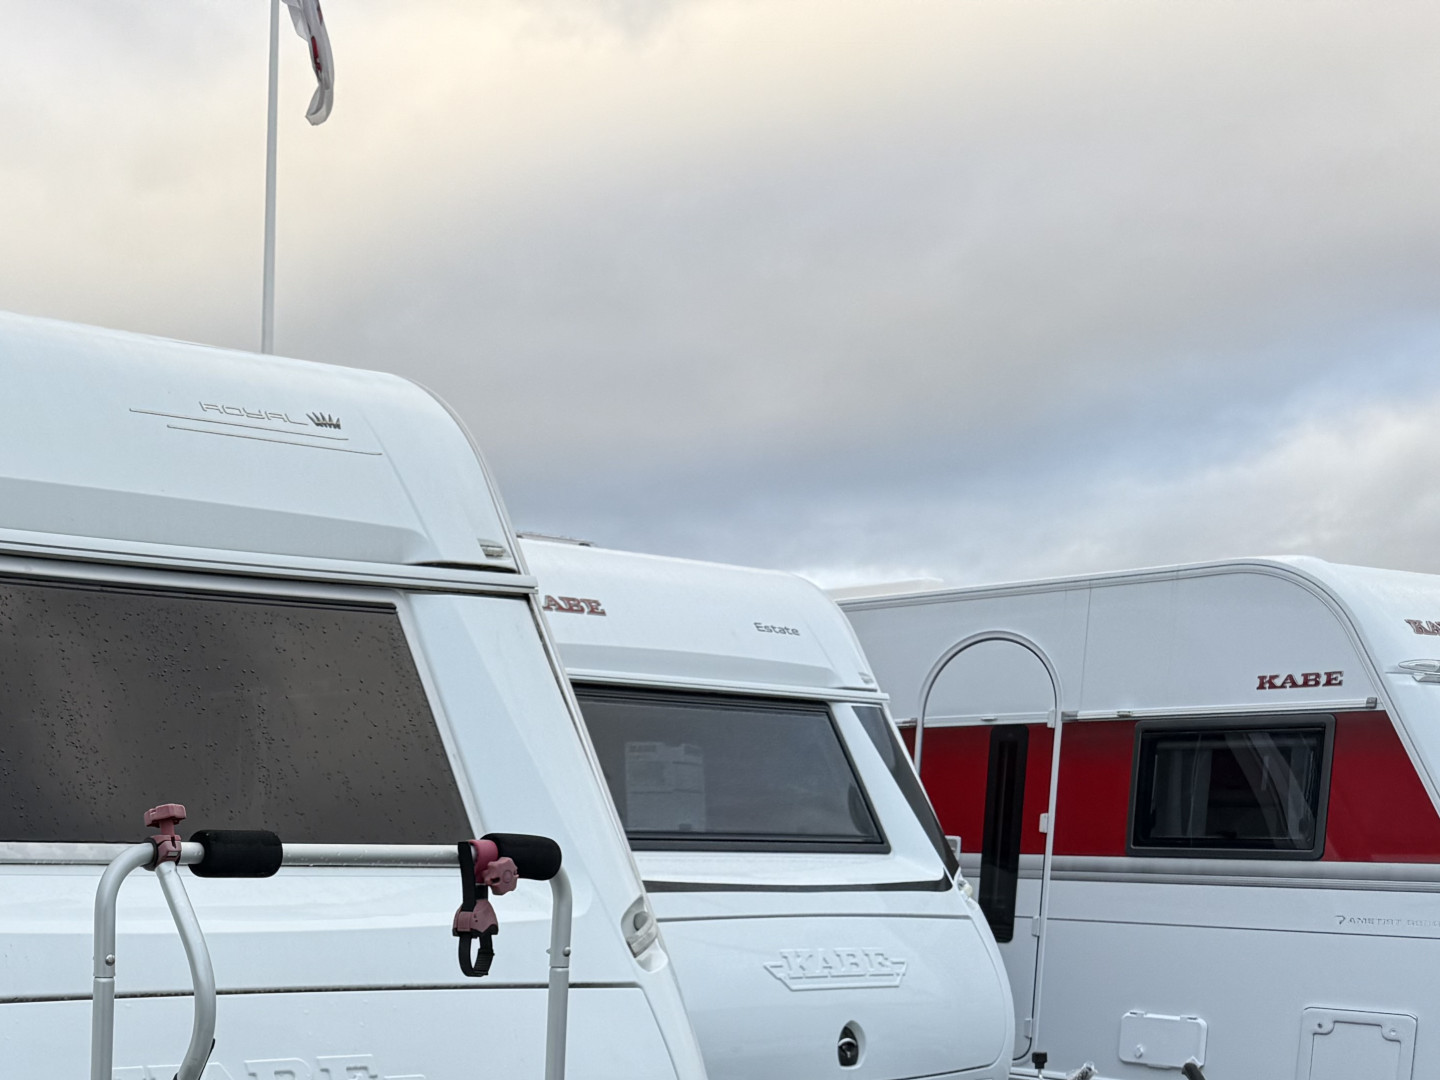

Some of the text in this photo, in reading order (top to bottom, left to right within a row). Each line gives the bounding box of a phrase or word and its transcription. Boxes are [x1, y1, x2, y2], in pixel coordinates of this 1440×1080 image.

[198, 400, 309, 426] ROYAL
[542, 594, 607, 617] ABE
[753, 621, 801, 637] Estate
[1256, 670, 1344, 690] KABE
[778, 948, 893, 980] KABE
